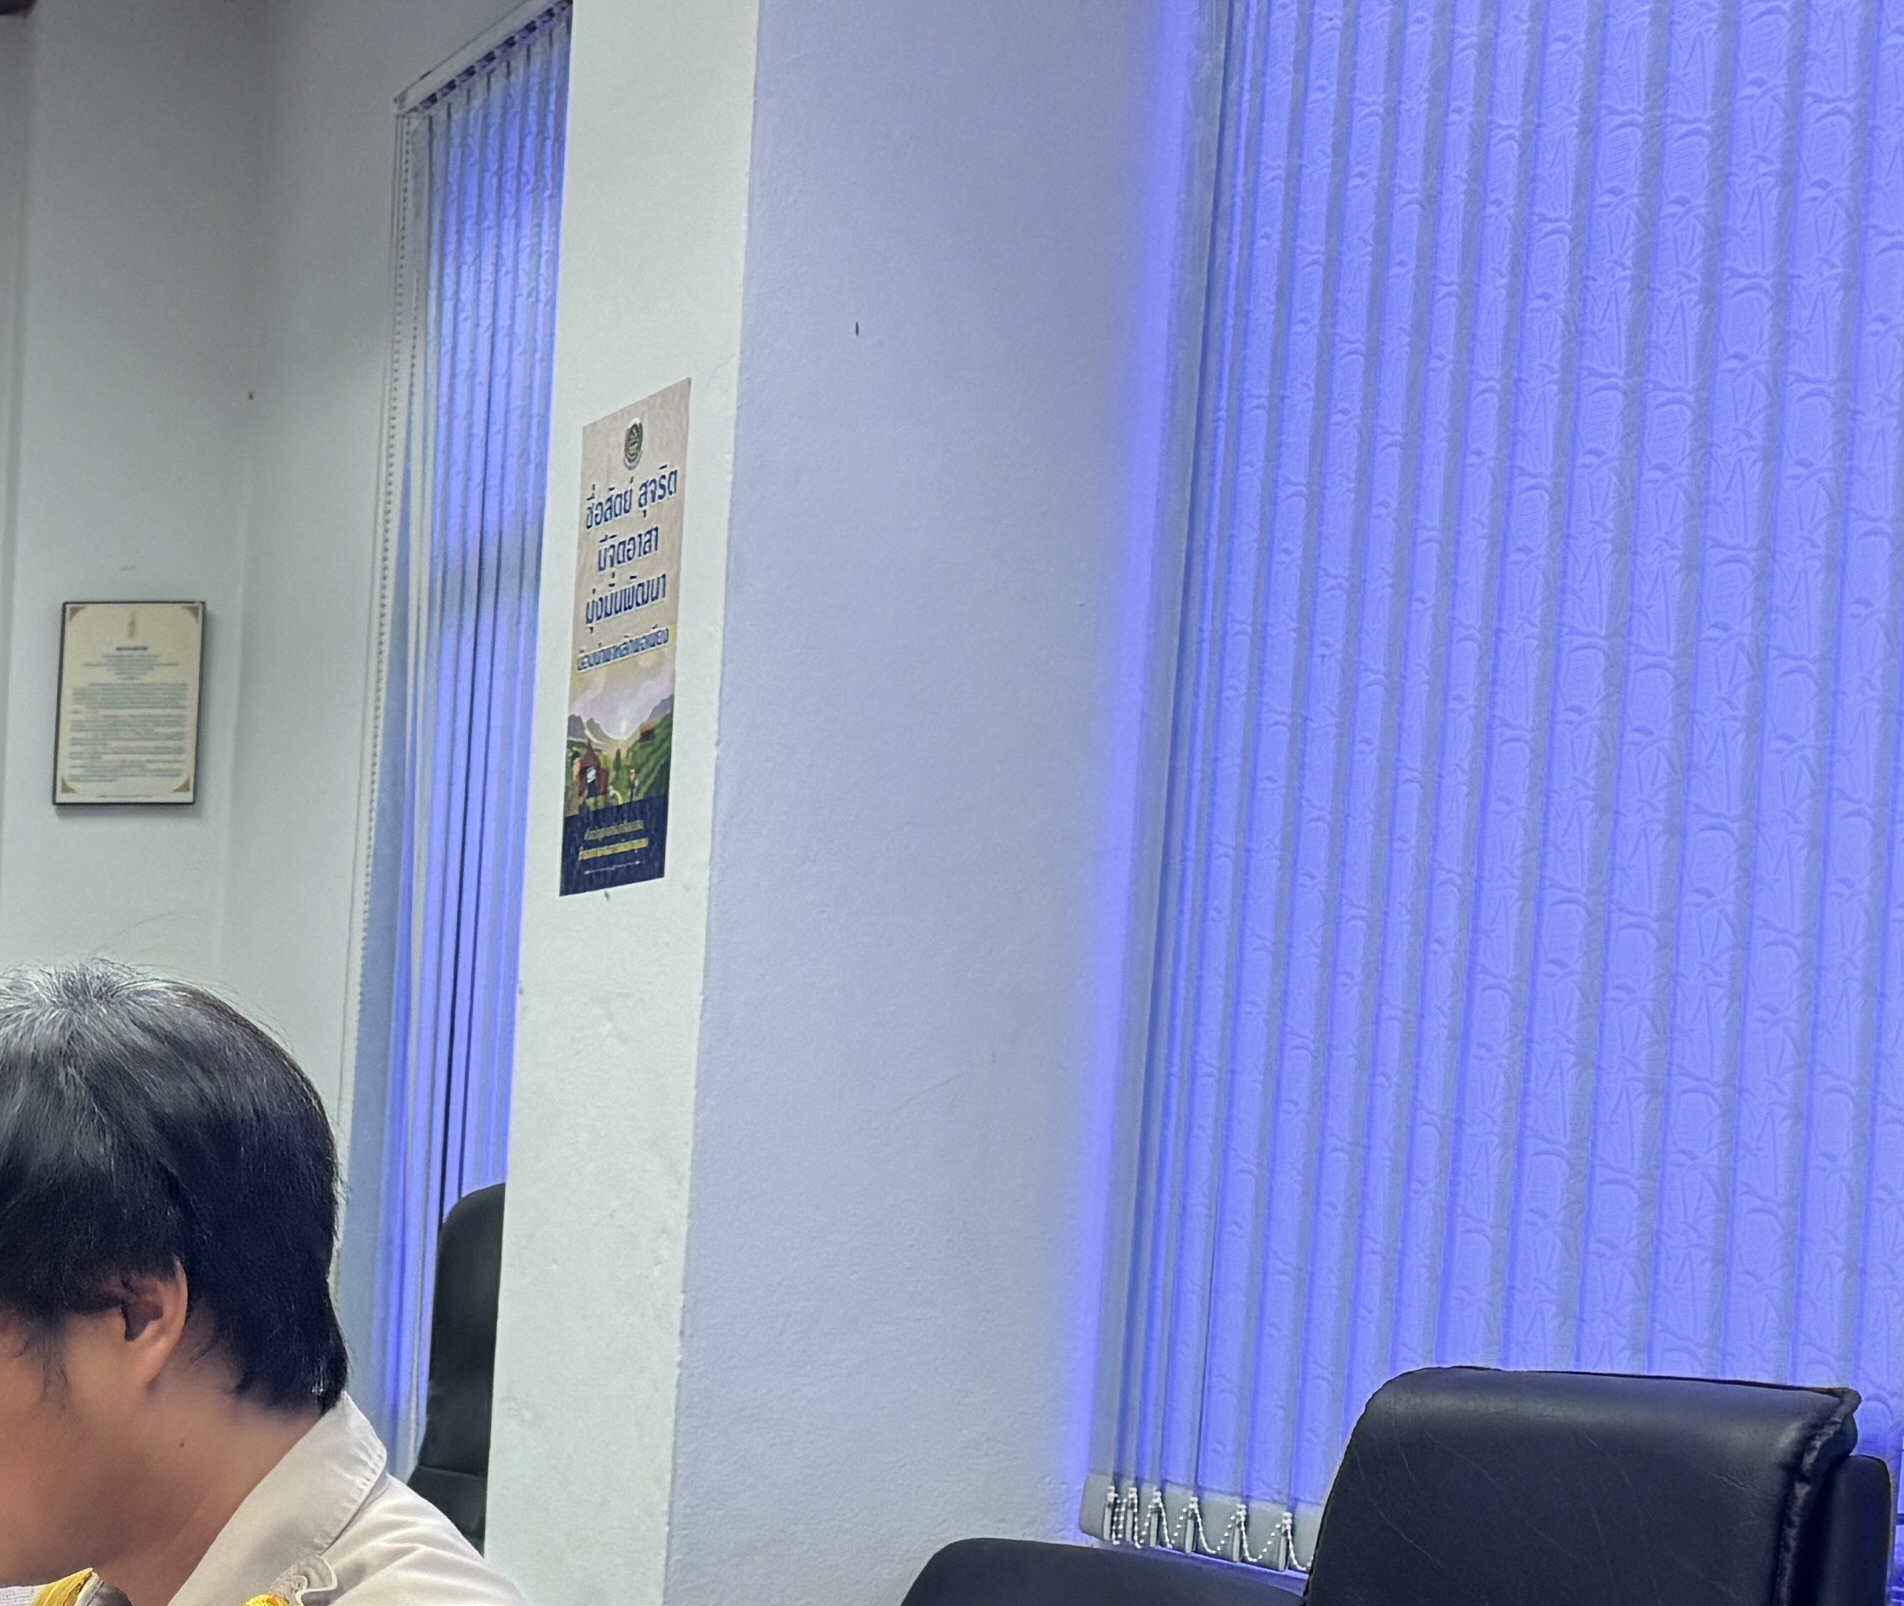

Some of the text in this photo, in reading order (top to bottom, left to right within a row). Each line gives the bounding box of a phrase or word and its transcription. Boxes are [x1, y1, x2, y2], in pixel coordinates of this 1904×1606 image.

[585, 465, 679, 530] ซื่อสัตย์ สุจริต
